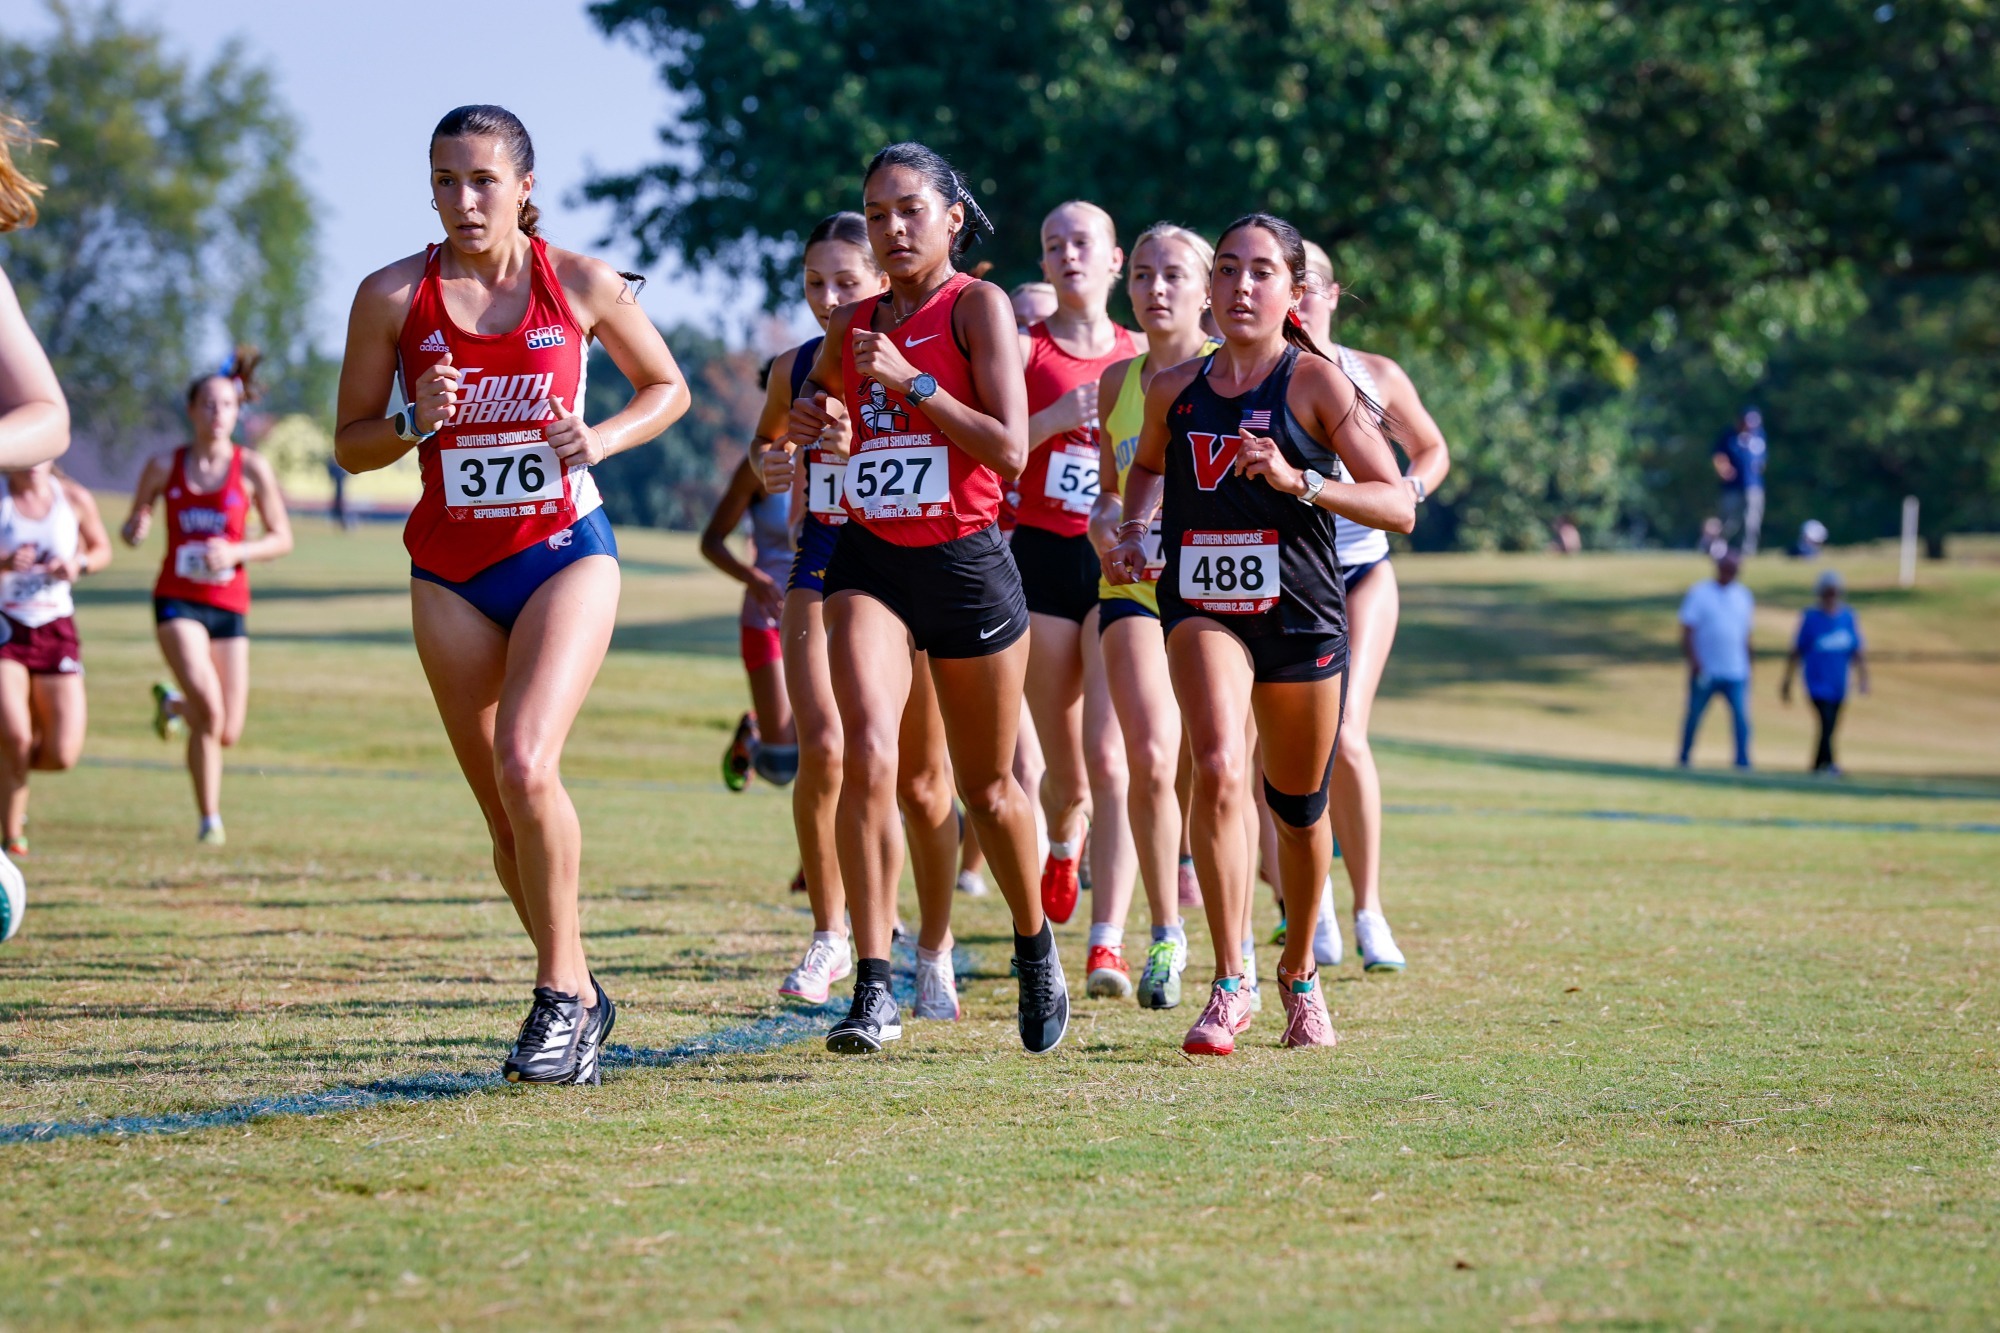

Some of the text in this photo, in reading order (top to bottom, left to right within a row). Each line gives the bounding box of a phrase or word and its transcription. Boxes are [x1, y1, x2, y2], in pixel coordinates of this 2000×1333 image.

[419, 344, 450, 353] adidas
[525, 324, 566, 350] SBC
[455, 367, 554, 405] SOUTH
[442, 397, 564, 426] LABAMA
[456, 428, 542, 447] SOUTHERN SHOWCASE
[860, 434, 932, 451] SOUTHERN SHOWCASE
[1186, 431, 1243, 491] V
[459, 453, 545, 497] 376
[856, 457, 932, 499] 527
[1059, 463, 1100, 497] 52
[473, 504, 536, 519] SEPTEMBER 12, 2025
[864, 508, 897, 519] SEPTEMBER
[906, 507, 922, 517] 2025
[1192, 532, 1264, 545] SOUTHERN SHOWCASE
[1191, 554, 1264, 592] 488
[1202, 602, 1231, 612] SEPTEMBER
